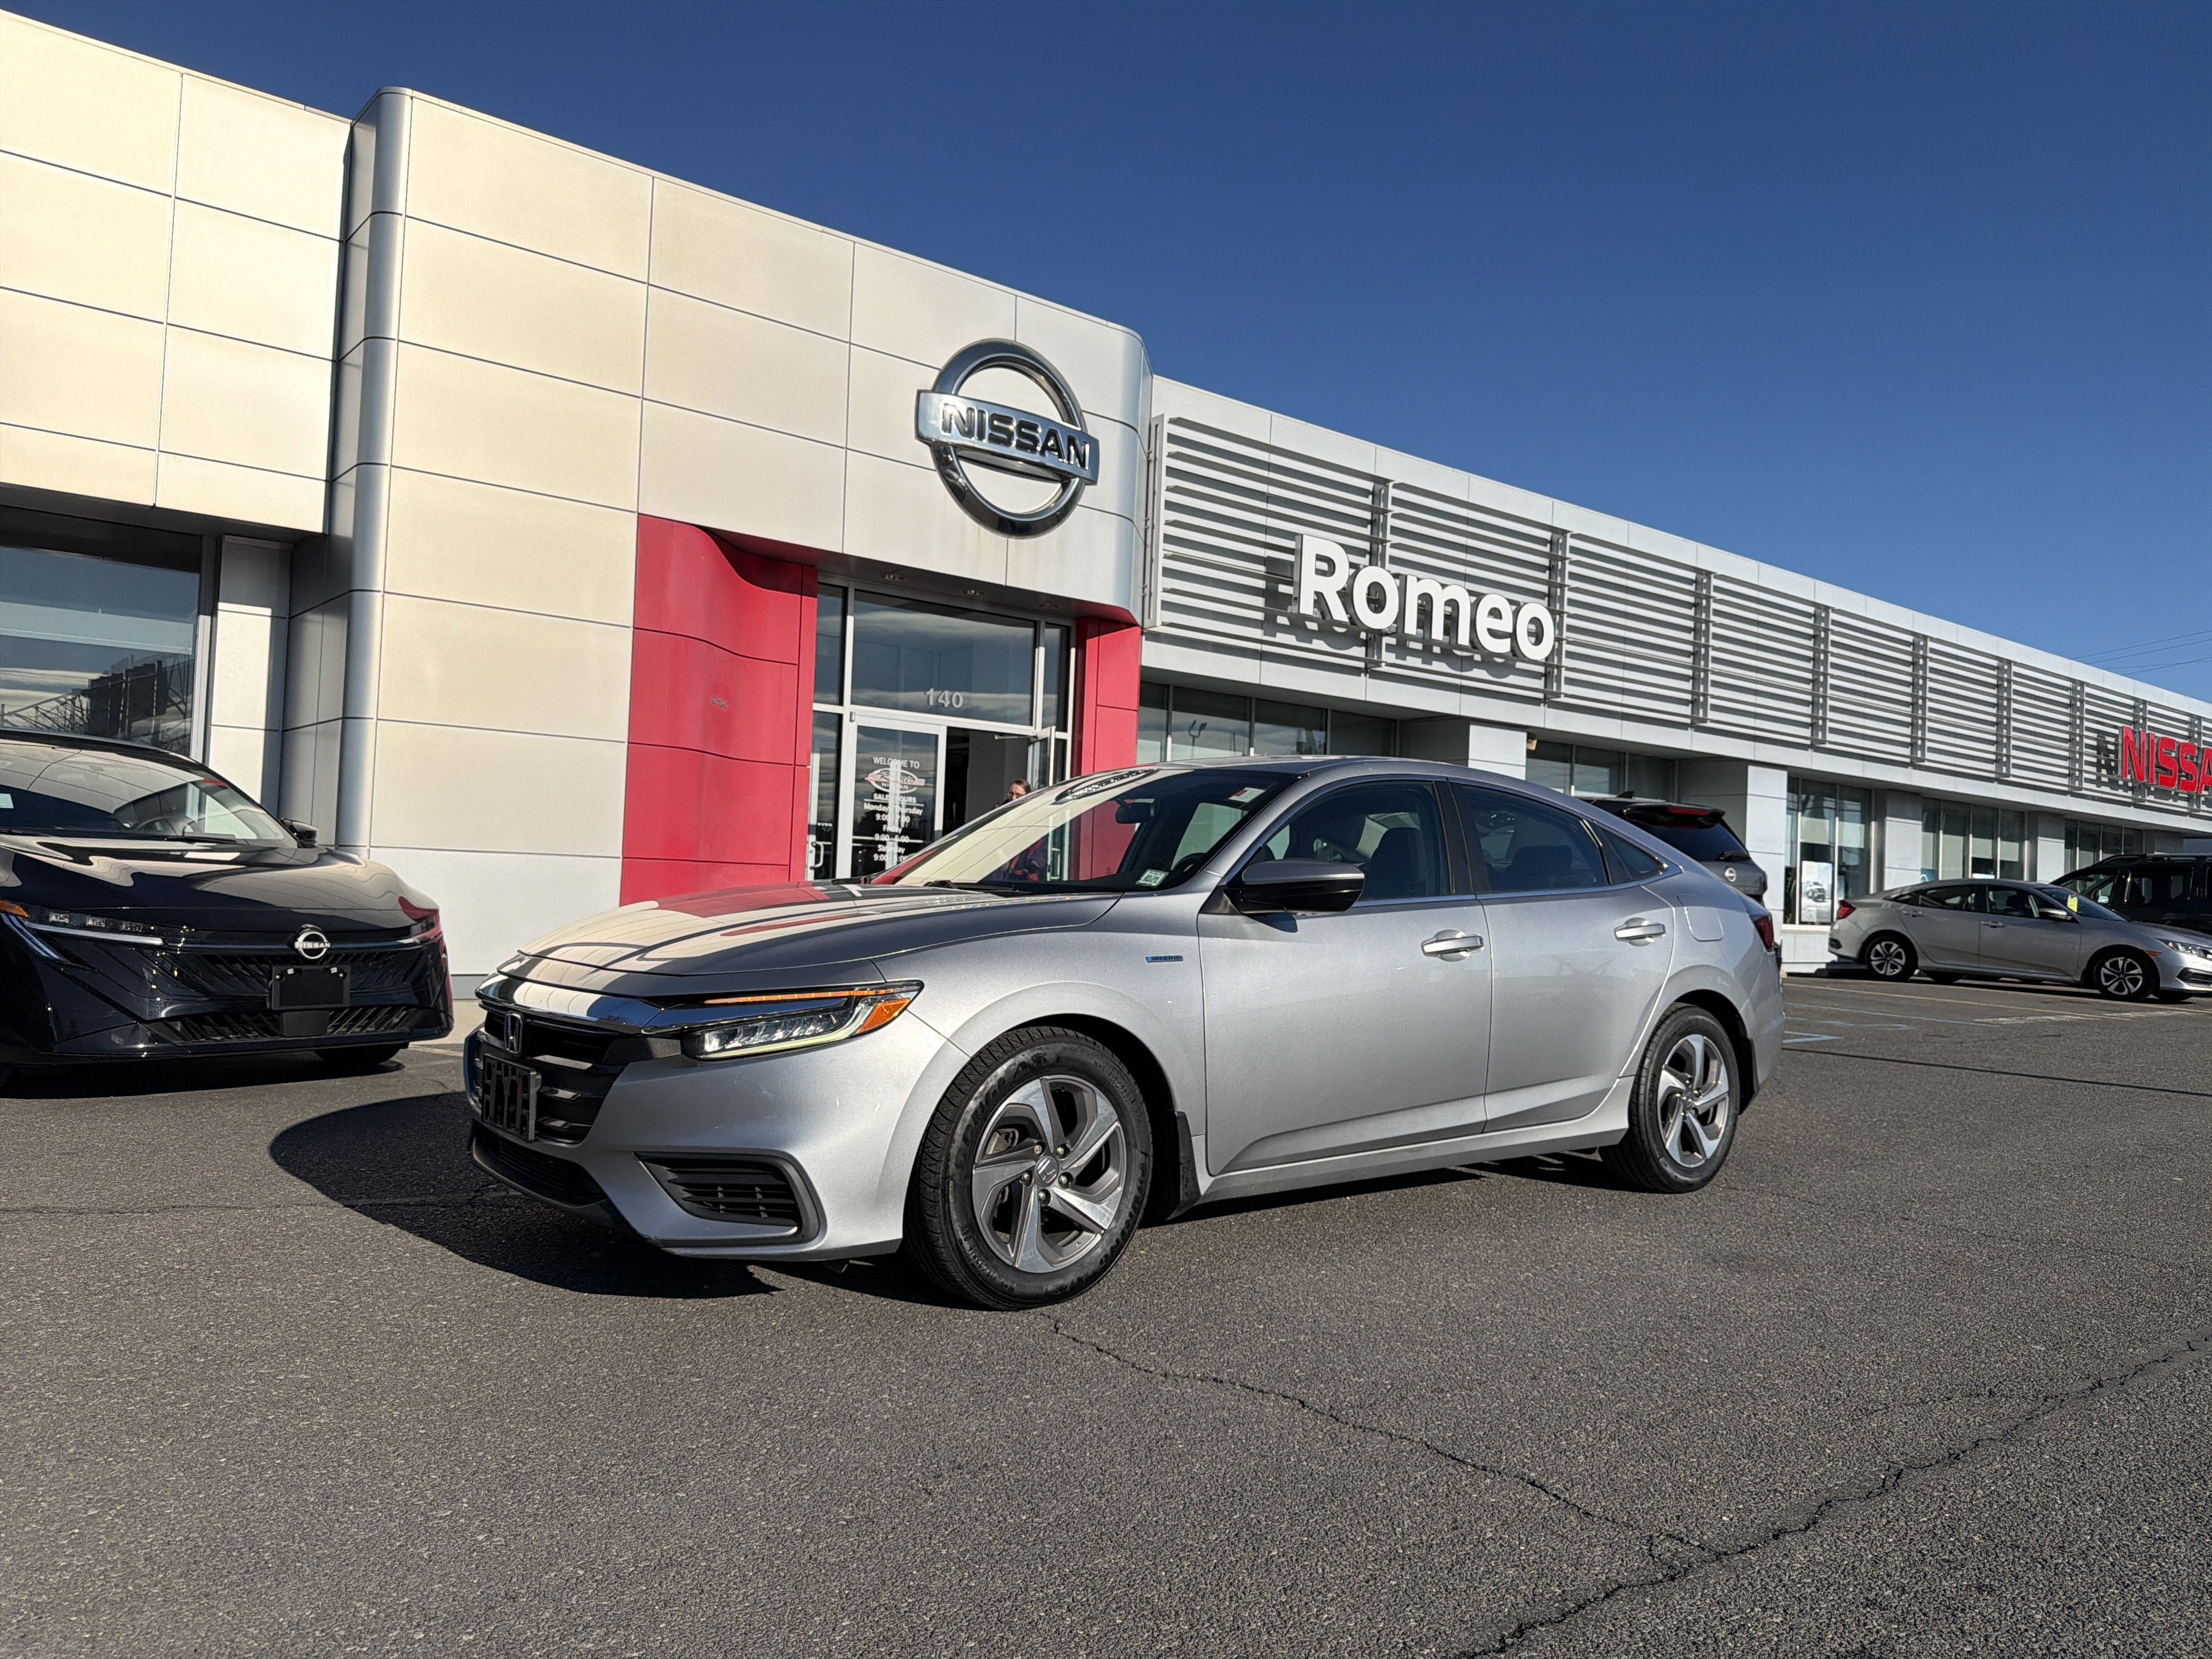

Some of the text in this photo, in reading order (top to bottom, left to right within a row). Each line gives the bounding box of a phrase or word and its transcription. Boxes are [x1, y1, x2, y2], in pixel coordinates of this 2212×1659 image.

[940, 403, 1090, 471] NISSAN
[1296, 534, 1555, 661] Romeo
[926, 688, 963, 708] 140
[873, 757, 920, 769] WELCOME TO
[2122, 726, 2212, 795] NISSA
[873, 793, 891, 802] SALE
[864, 802, 889, 812] Monday
[895, 805, 923, 816] Thursday
[875, 812, 890, 822] 9:00
[882, 824, 902, 834] Friday
[874, 833, 889, 842] 9:00
[878, 844, 906, 855] Saturday
[873, 853, 888, 862] 9:00
